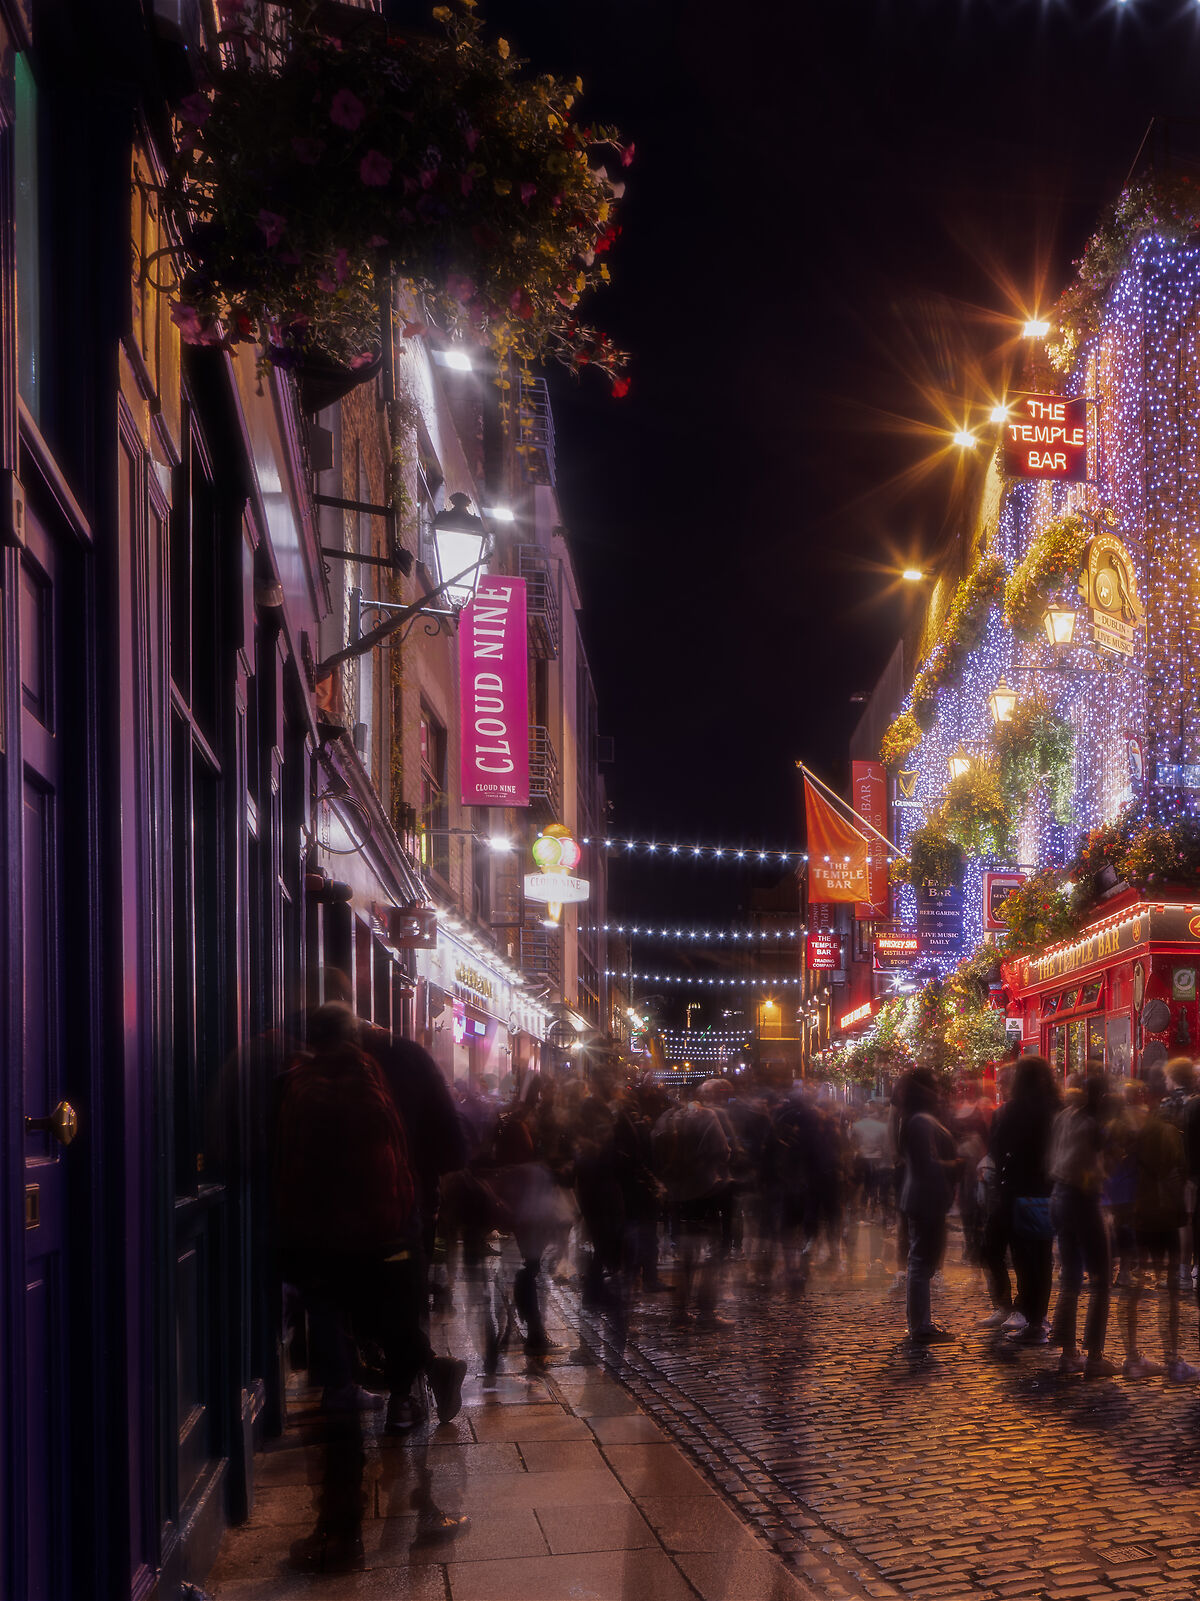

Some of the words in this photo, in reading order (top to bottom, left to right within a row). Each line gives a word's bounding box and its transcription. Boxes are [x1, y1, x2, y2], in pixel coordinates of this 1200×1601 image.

[1027, 400, 1066, 421] THE
[1008, 424, 1085, 446] TEMPLE
[1028, 451, 1067, 470] BAR
[473, 586, 513, 660] NINE
[1102, 615, 1127, 634] DUBLIN
[1097, 630, 1112, 643] LIVE
[1112, 638, 1132, 654] MUSIC
[474, 672, 515, 774] CLOUD
[475, 783, 498, 792] CLOUD
[499, 784, 517, 794] NINE
[861, 784, 872, 811] BAR
[813, 868, 865, 880] TEMPLE
[829, 861, 849, 870] THE
[827, 880, 853, 889] BAR
[816, 948, 832, 956] BAR
[879, 939, 904, 949] WHISKEY
[904, 940, 917, 949] SHO
[1038, 956, 1055, 980] THE
[1058, 942, 1094, 973] TEMPLE
[1098, 927, 1120, 957] BAR
